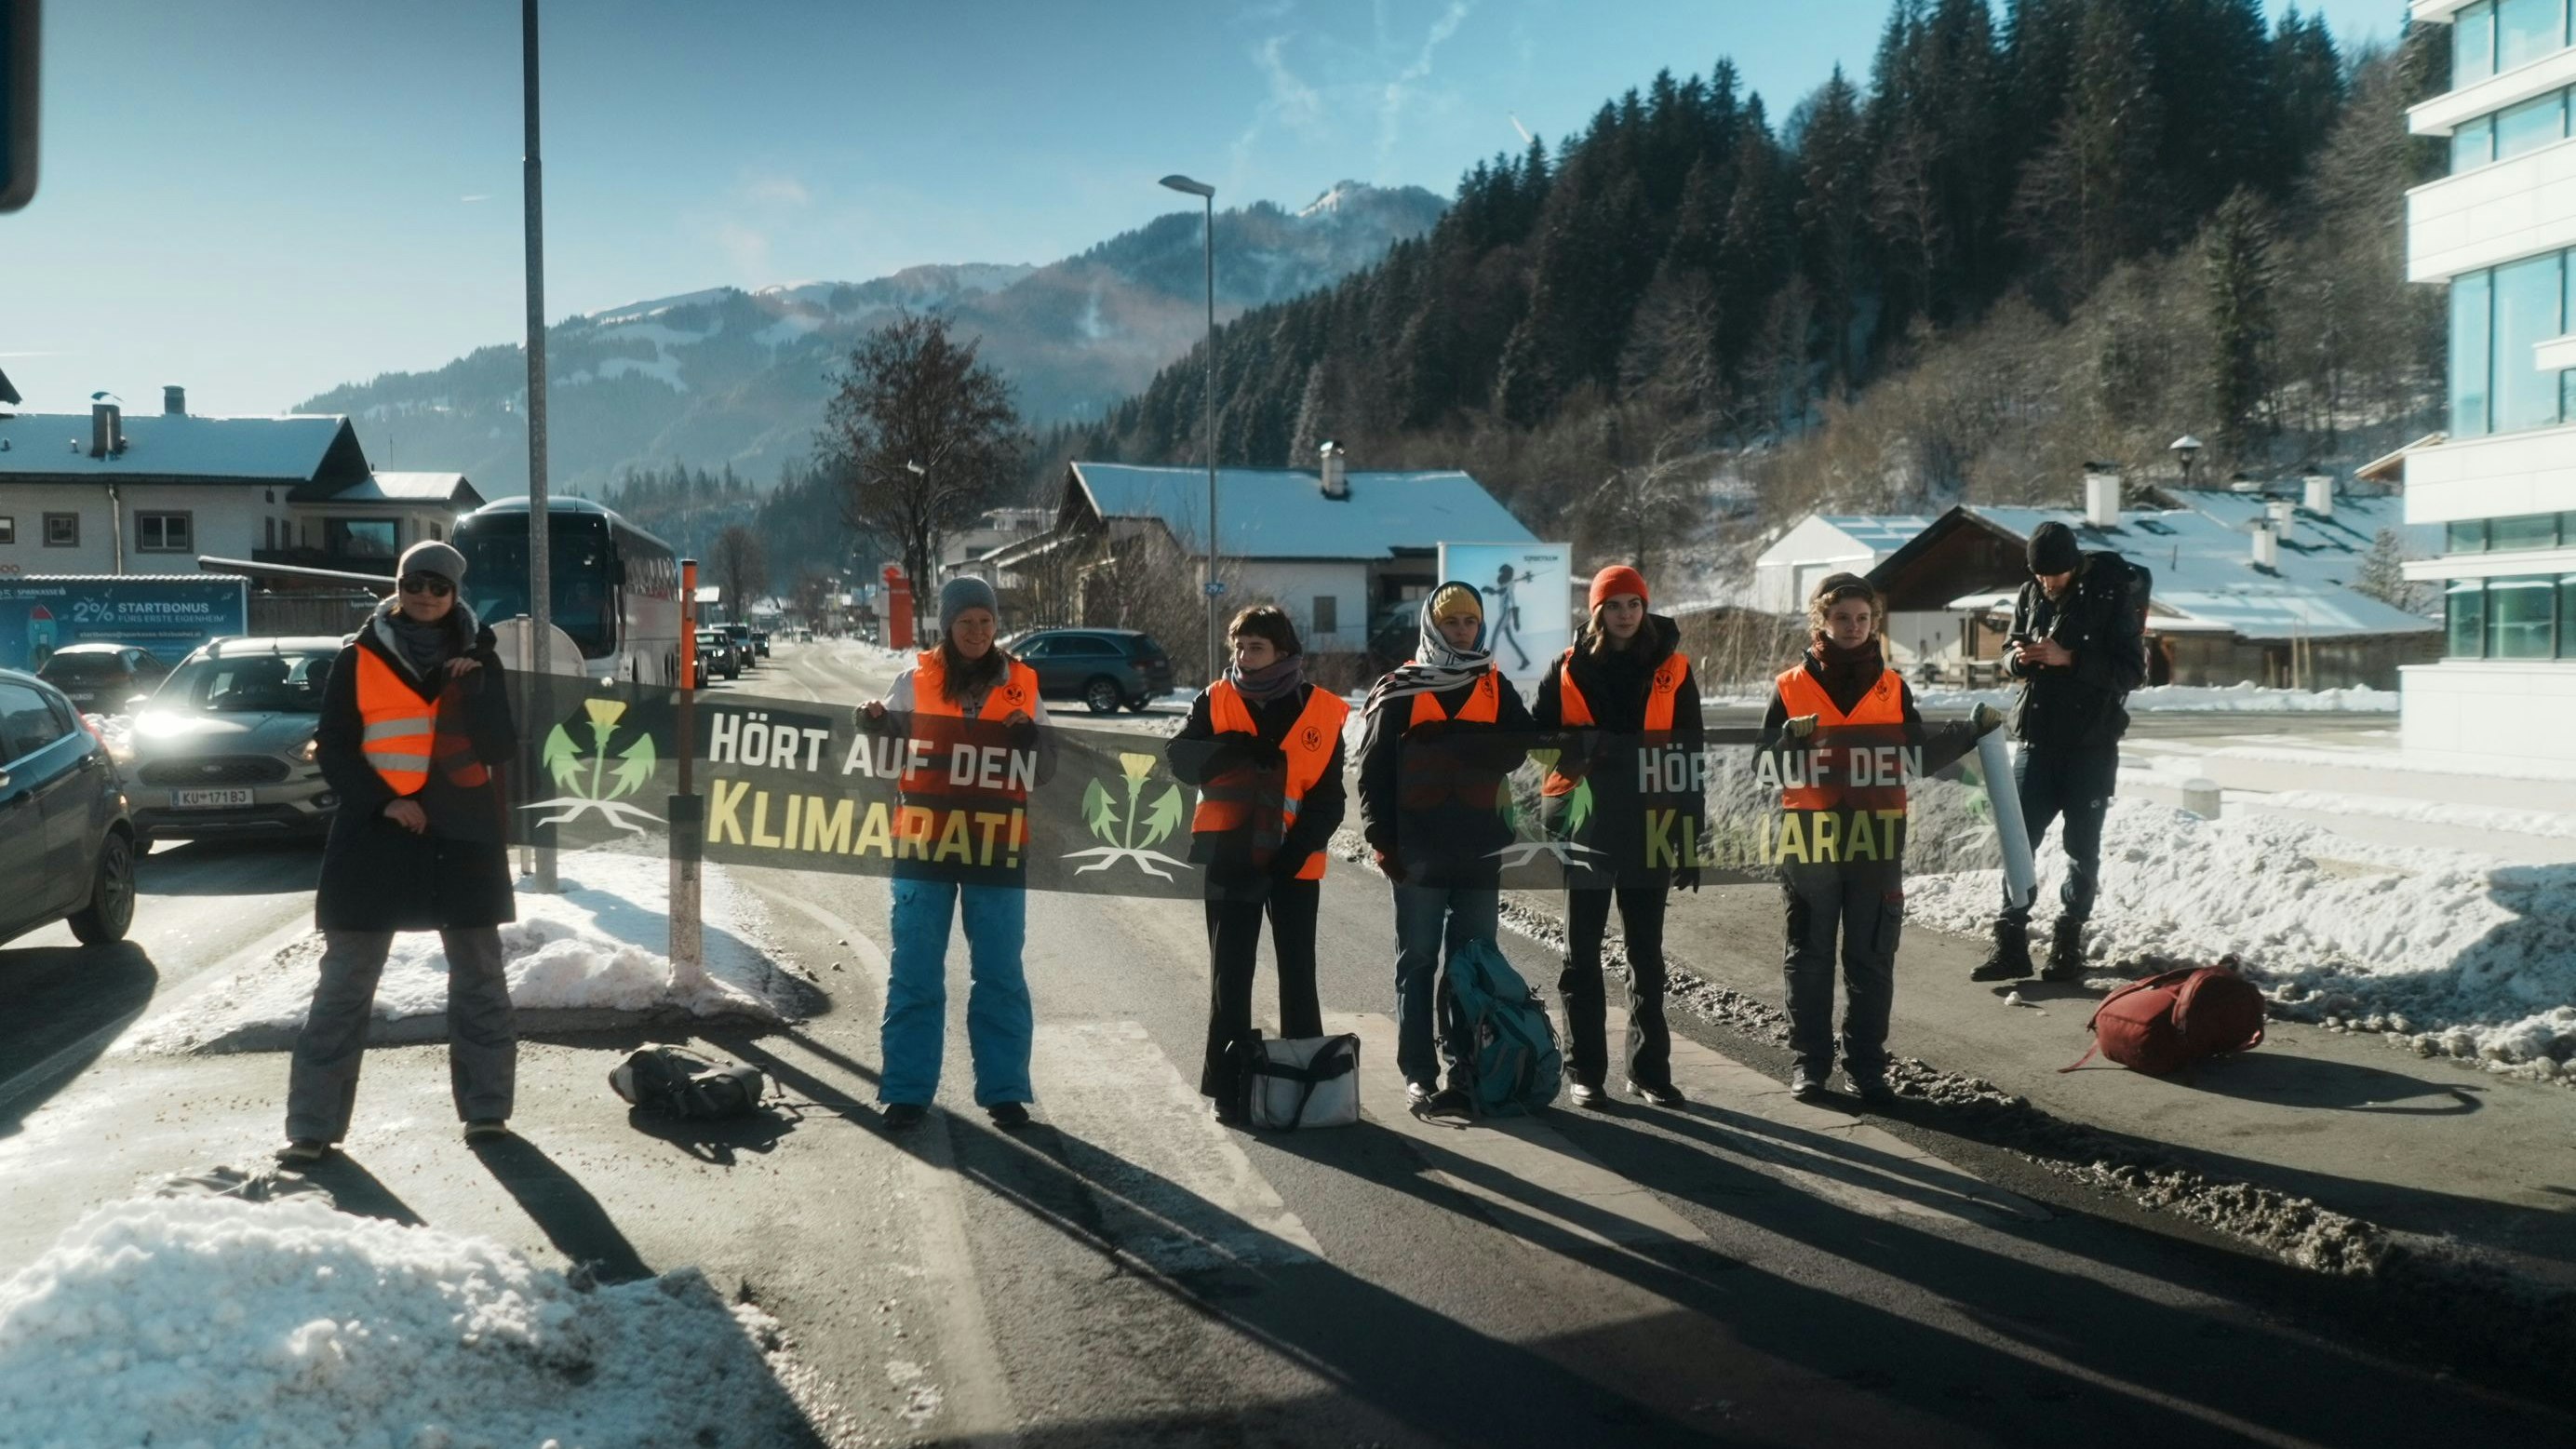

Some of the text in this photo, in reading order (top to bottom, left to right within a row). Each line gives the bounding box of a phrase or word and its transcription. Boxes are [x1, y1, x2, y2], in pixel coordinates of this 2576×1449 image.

[73, 602, 114, 623] 2%
[117, 603, 209, 613] STARTBONUS
[709, 712, 1037, 792] HÖRT AUF DEN
[1638, 743, 1922, 793] HÖR AUF DEN
[182, 792, 199, 804] KU
[707, 779, 1024, 867] KLIMARAT!
